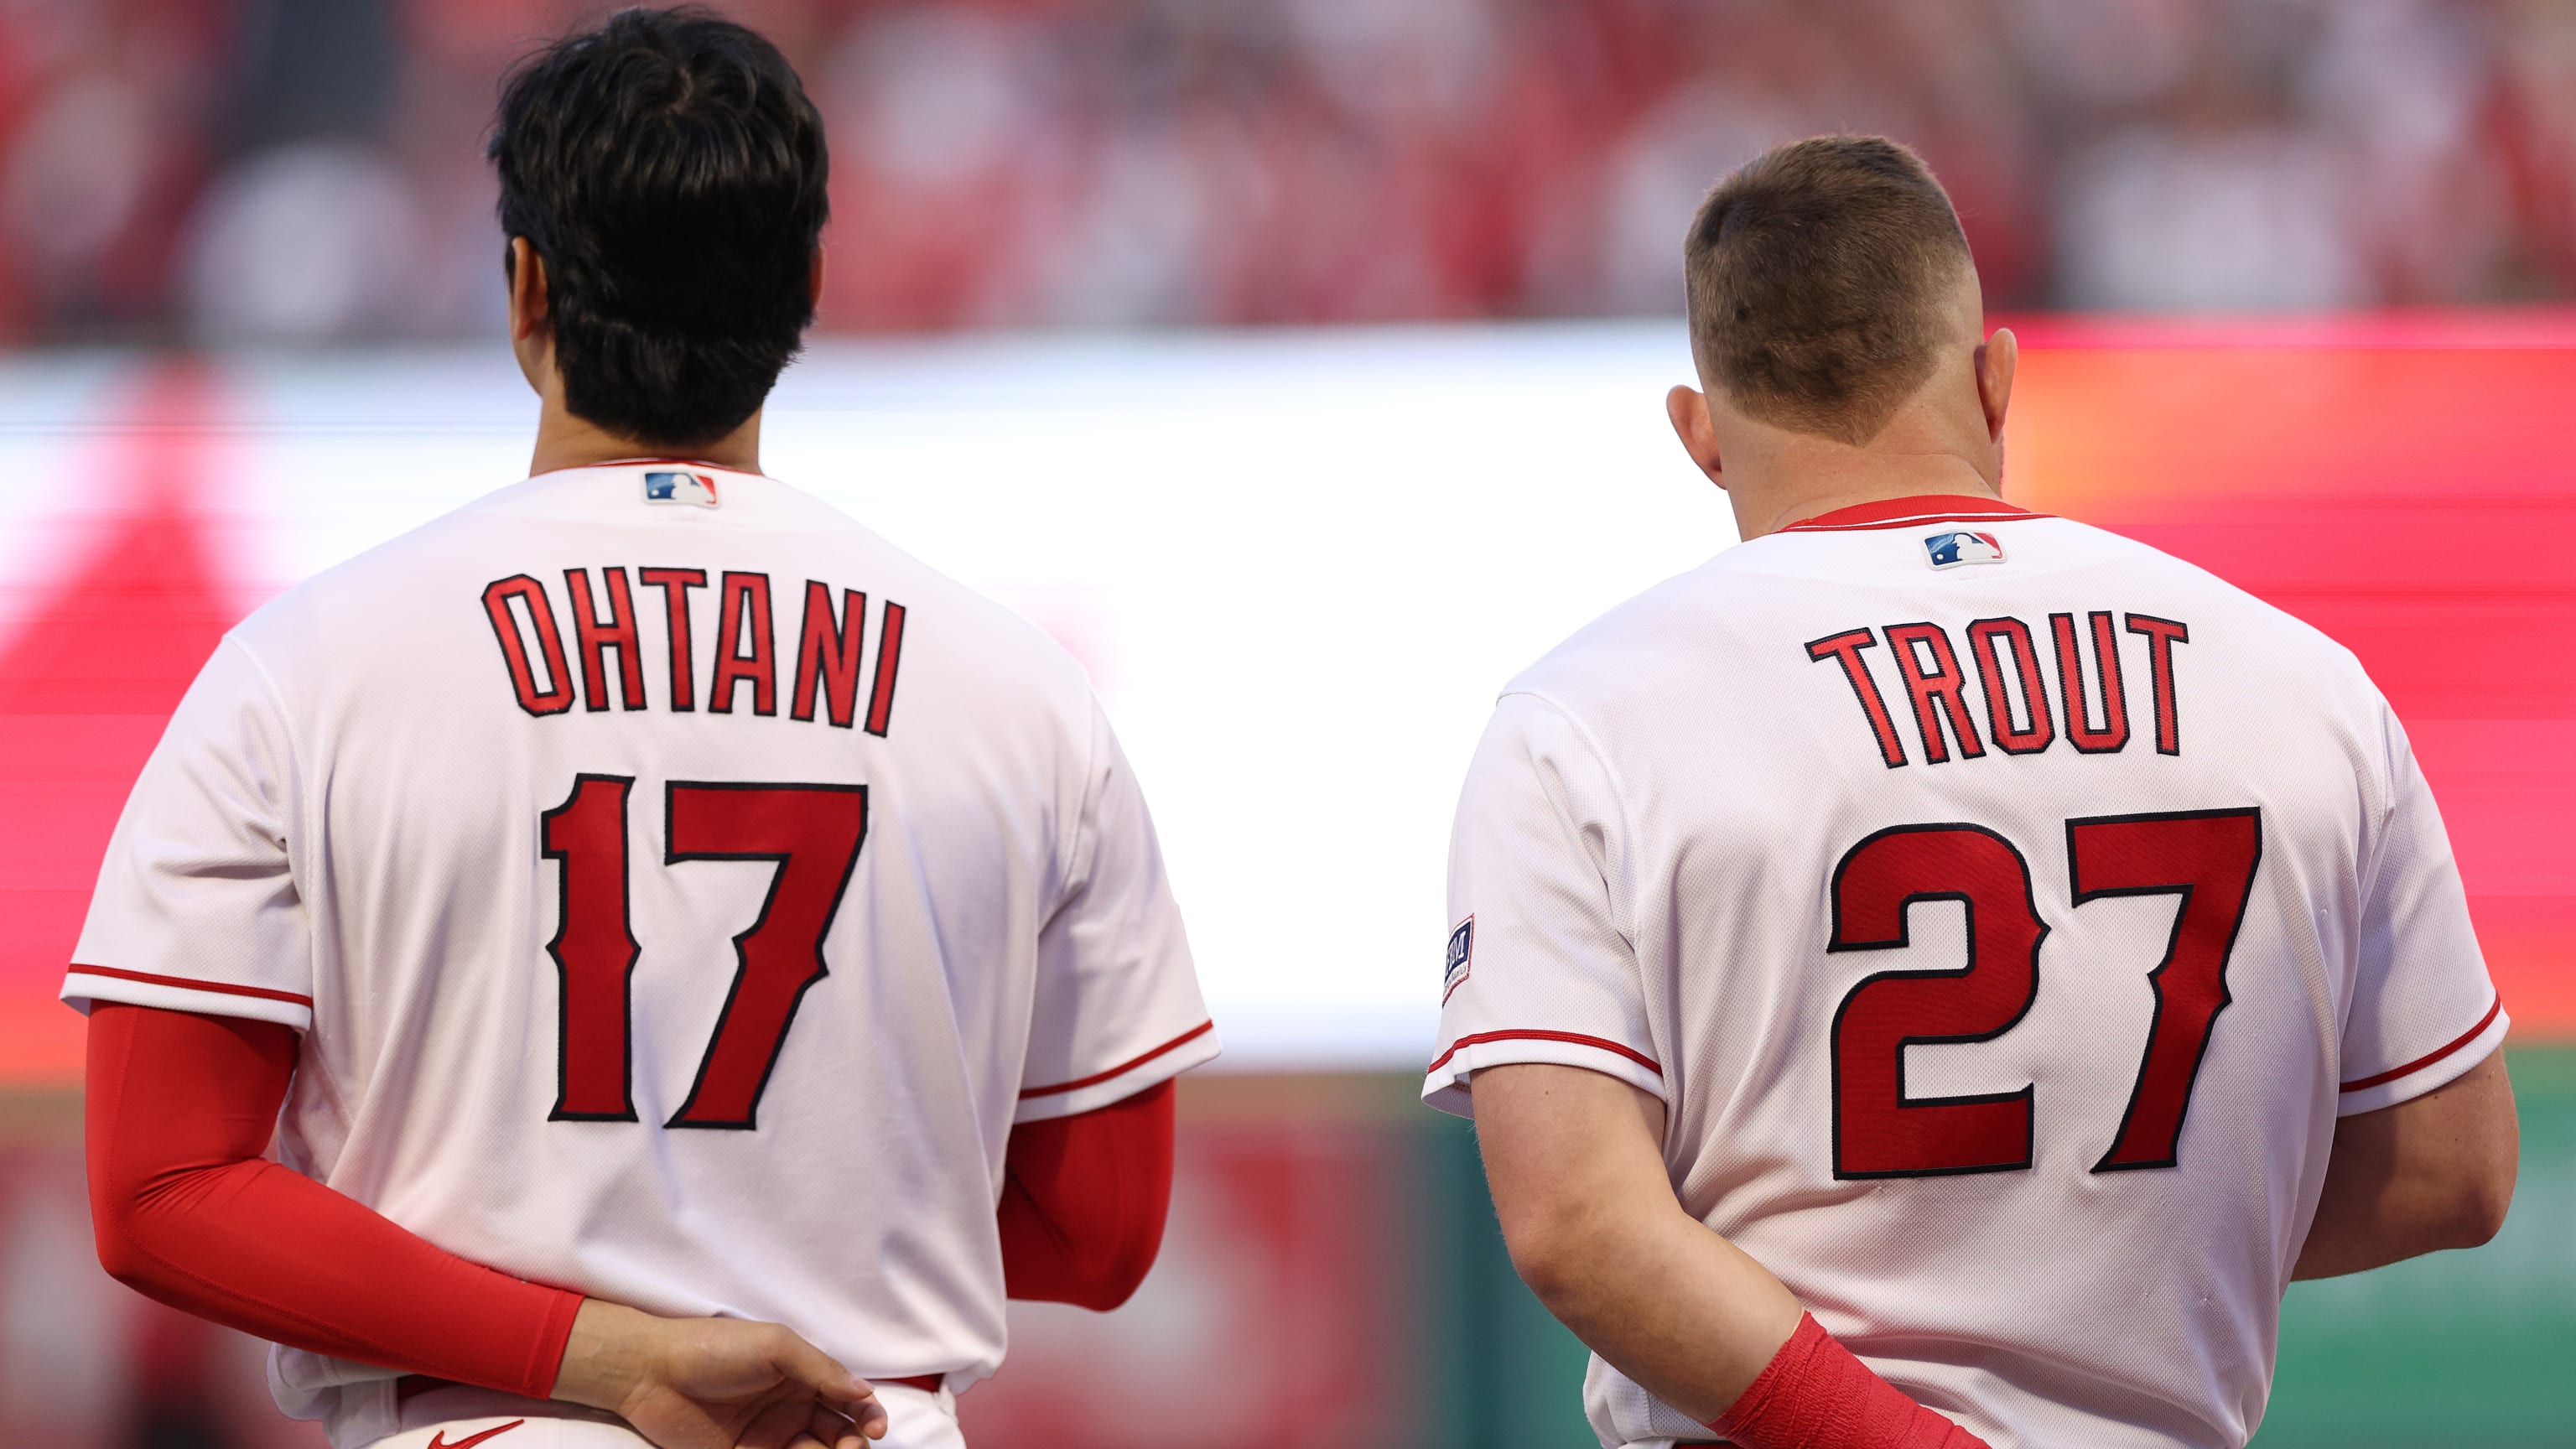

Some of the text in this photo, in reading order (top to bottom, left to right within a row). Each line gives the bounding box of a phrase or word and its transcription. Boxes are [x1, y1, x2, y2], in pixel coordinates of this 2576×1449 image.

[481, 567, 906, 739] OHTANI
[1804, 610, 2189, 770] TROUT
[541, 773, 870, 1132] 17
[1826, 805, 2263, 1180] 27
